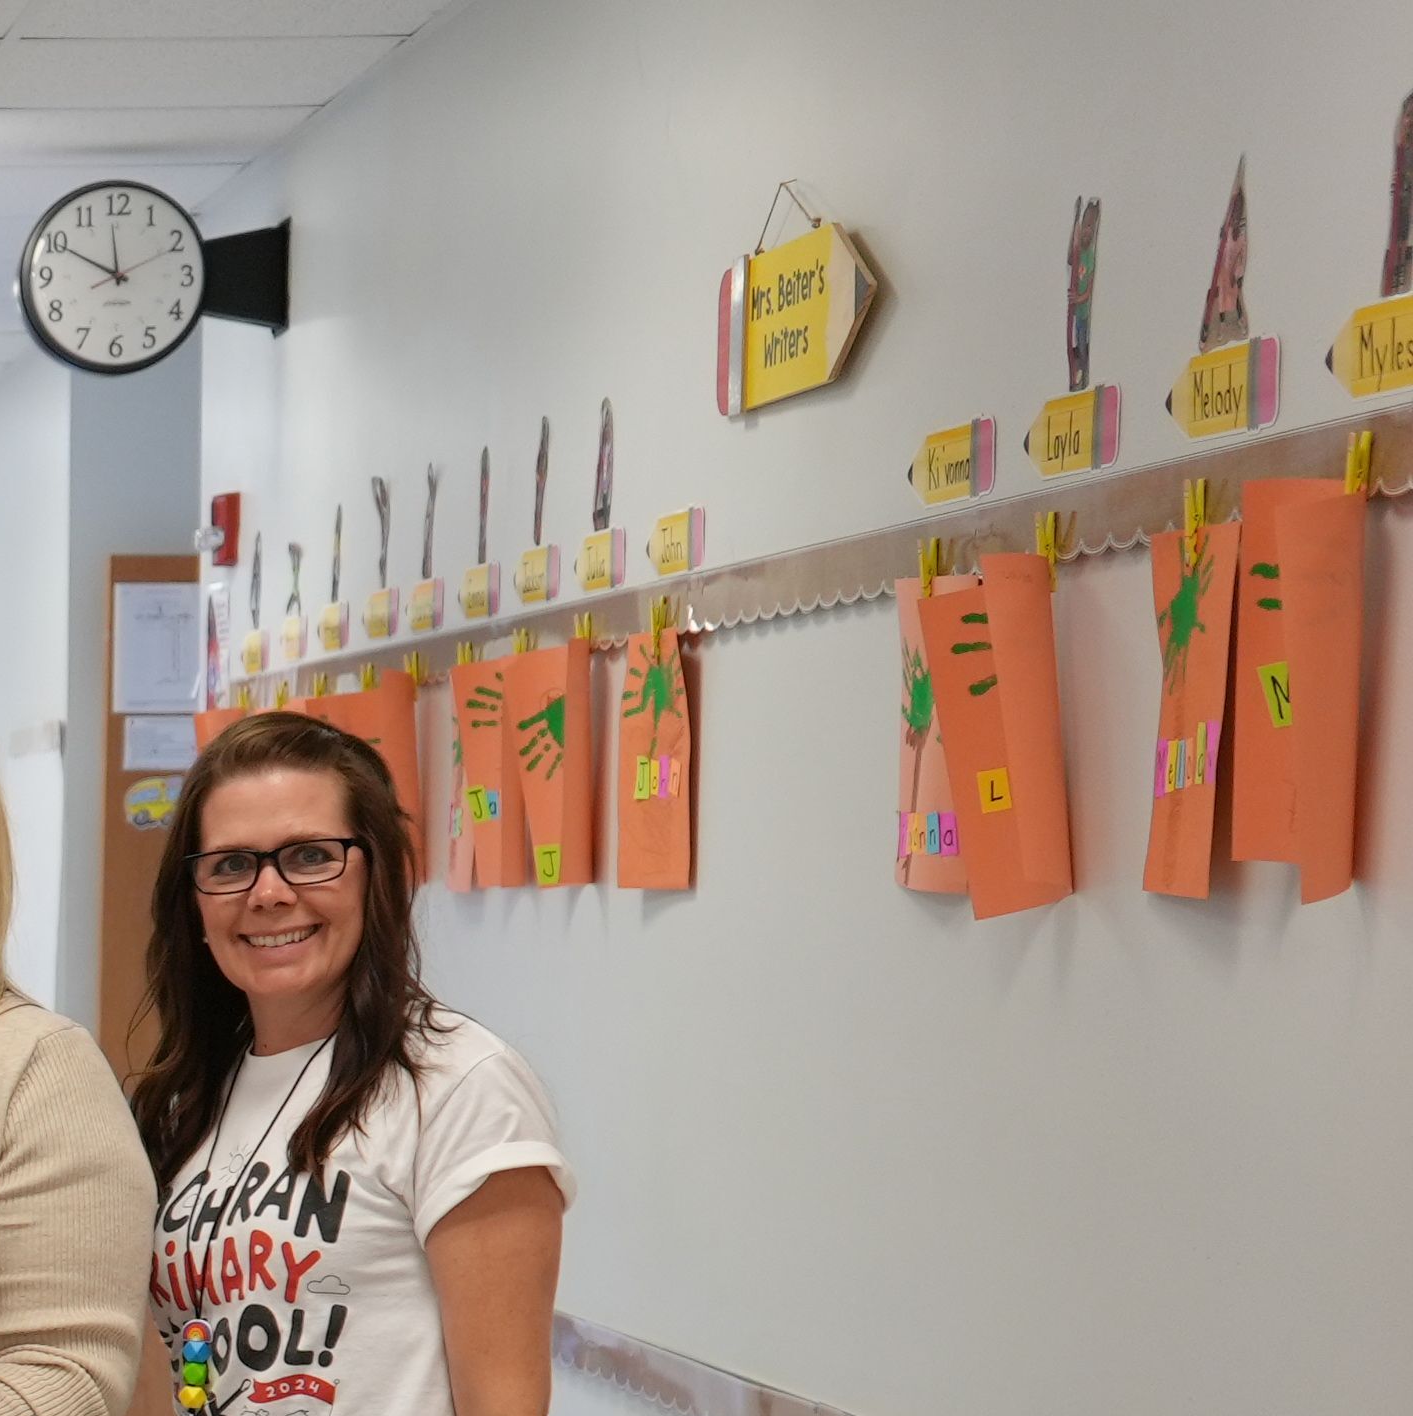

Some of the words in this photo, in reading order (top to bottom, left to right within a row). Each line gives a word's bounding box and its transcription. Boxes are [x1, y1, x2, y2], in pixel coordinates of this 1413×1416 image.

[106, 193, 131, 216] 12
[76, 206, 93, 227] 11
[146, 205, 156, 227] 1
[46, 231, 68, 253] 10
[170, 230, 185, 252] 2
[39, 266, 53, 289] 9
[179, 265, 194, 287] 3
[751, 286, 774, 322] Mrs.
[778, 258, 825, 313] Beiter's
[48, 300, 63, 322] 8
[168, 299, 184, 321] 4
[76, 327, 91, 350] 7
[109, 335, 123, 358] 6
[143, 327, 157, 349] 5
[764, 325, 809, 369] Writers
[1192, 364, 1243, 428] Melody
[1046, 411, 1080, 470] Layla
[661, 526, 683, 564] John
[990, 780, 1004, 802] L
[266, 1379, 321, 1399] 2024
